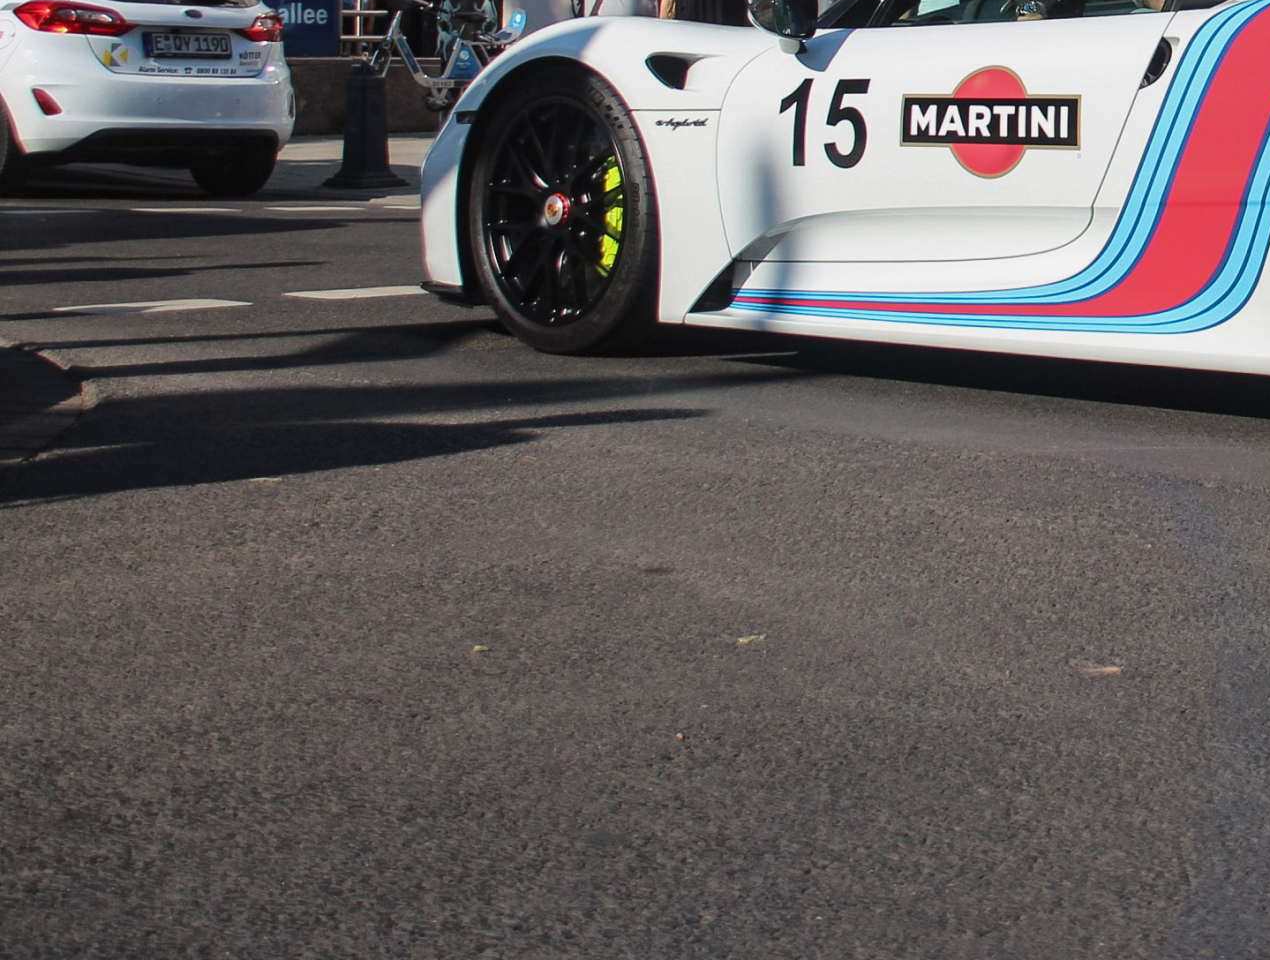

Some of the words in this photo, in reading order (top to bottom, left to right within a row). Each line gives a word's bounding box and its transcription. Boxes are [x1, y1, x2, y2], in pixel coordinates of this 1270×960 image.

[154, 37, 164, 51] E
[173, 36, 190, 51] QY
[194, 38, 229, 53] 1190
[779, 77, 871, 169] 15
[909, 104, 1069, 139] MARTINI
